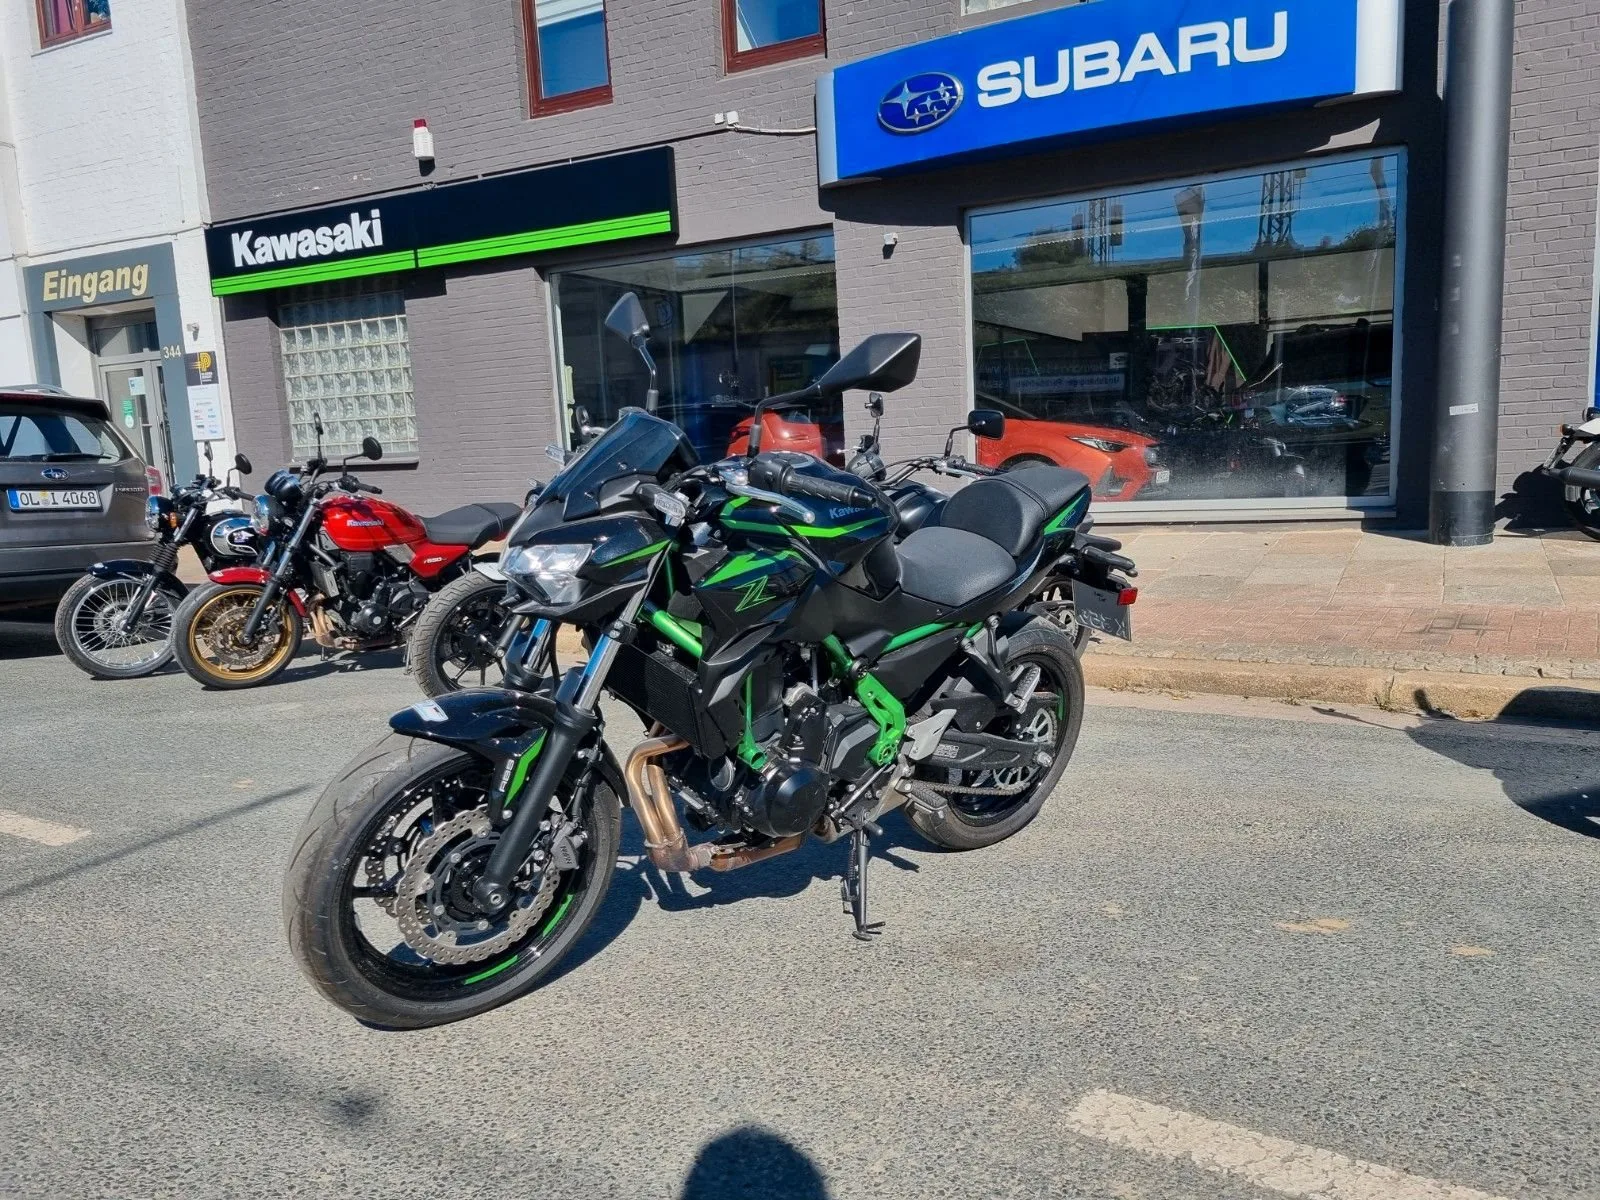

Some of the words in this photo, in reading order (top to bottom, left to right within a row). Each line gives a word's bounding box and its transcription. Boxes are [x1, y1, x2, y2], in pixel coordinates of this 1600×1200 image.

[977, 11, 1288, 108] SUBARU
[231, 208, 383, 267] Kawasaki
[43, 264, 149, 303] Eingang
[163, 345, 181, 358] 344
[20, 492, 40, 506] OL
[62, 490, 97, 505] 4068
[499, 759, 514, 792] ABS
